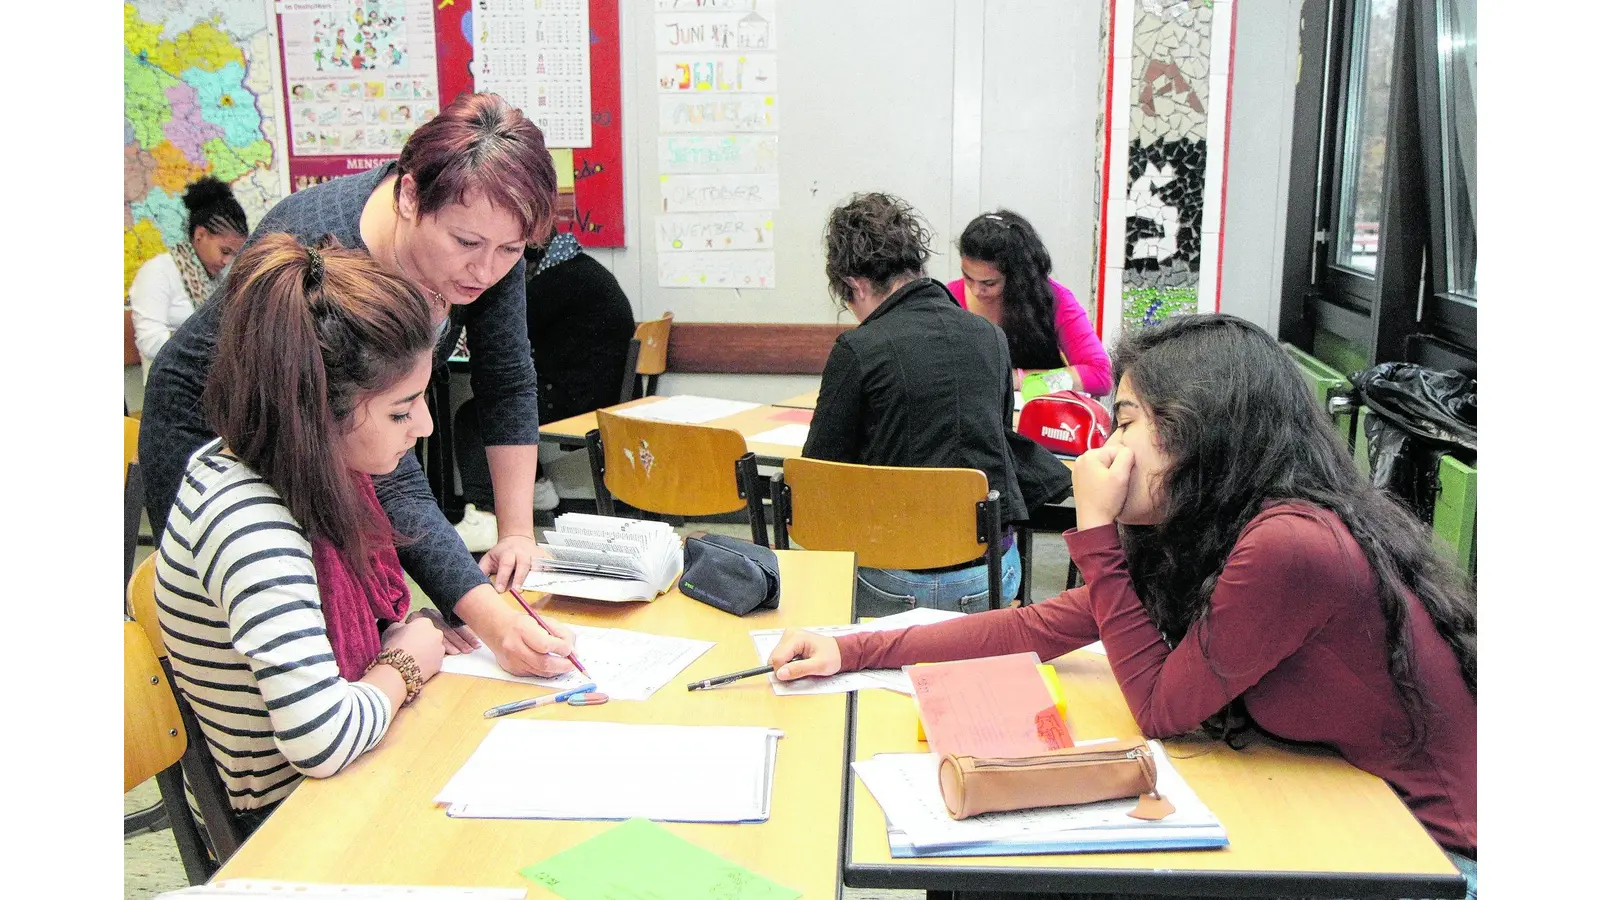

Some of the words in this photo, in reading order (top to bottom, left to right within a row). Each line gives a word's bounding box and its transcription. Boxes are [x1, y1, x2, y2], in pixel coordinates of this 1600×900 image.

[665, 21, 705, 46] JUNI
[674, 55, 748, 92] JULI
[346, 157, 390, 170] MENSC
[672, 184, 763, 205] OKTOBER
[660, 221, 748, 243] NOVEMBER
[1041, 425, 1070, 442] PUMA
